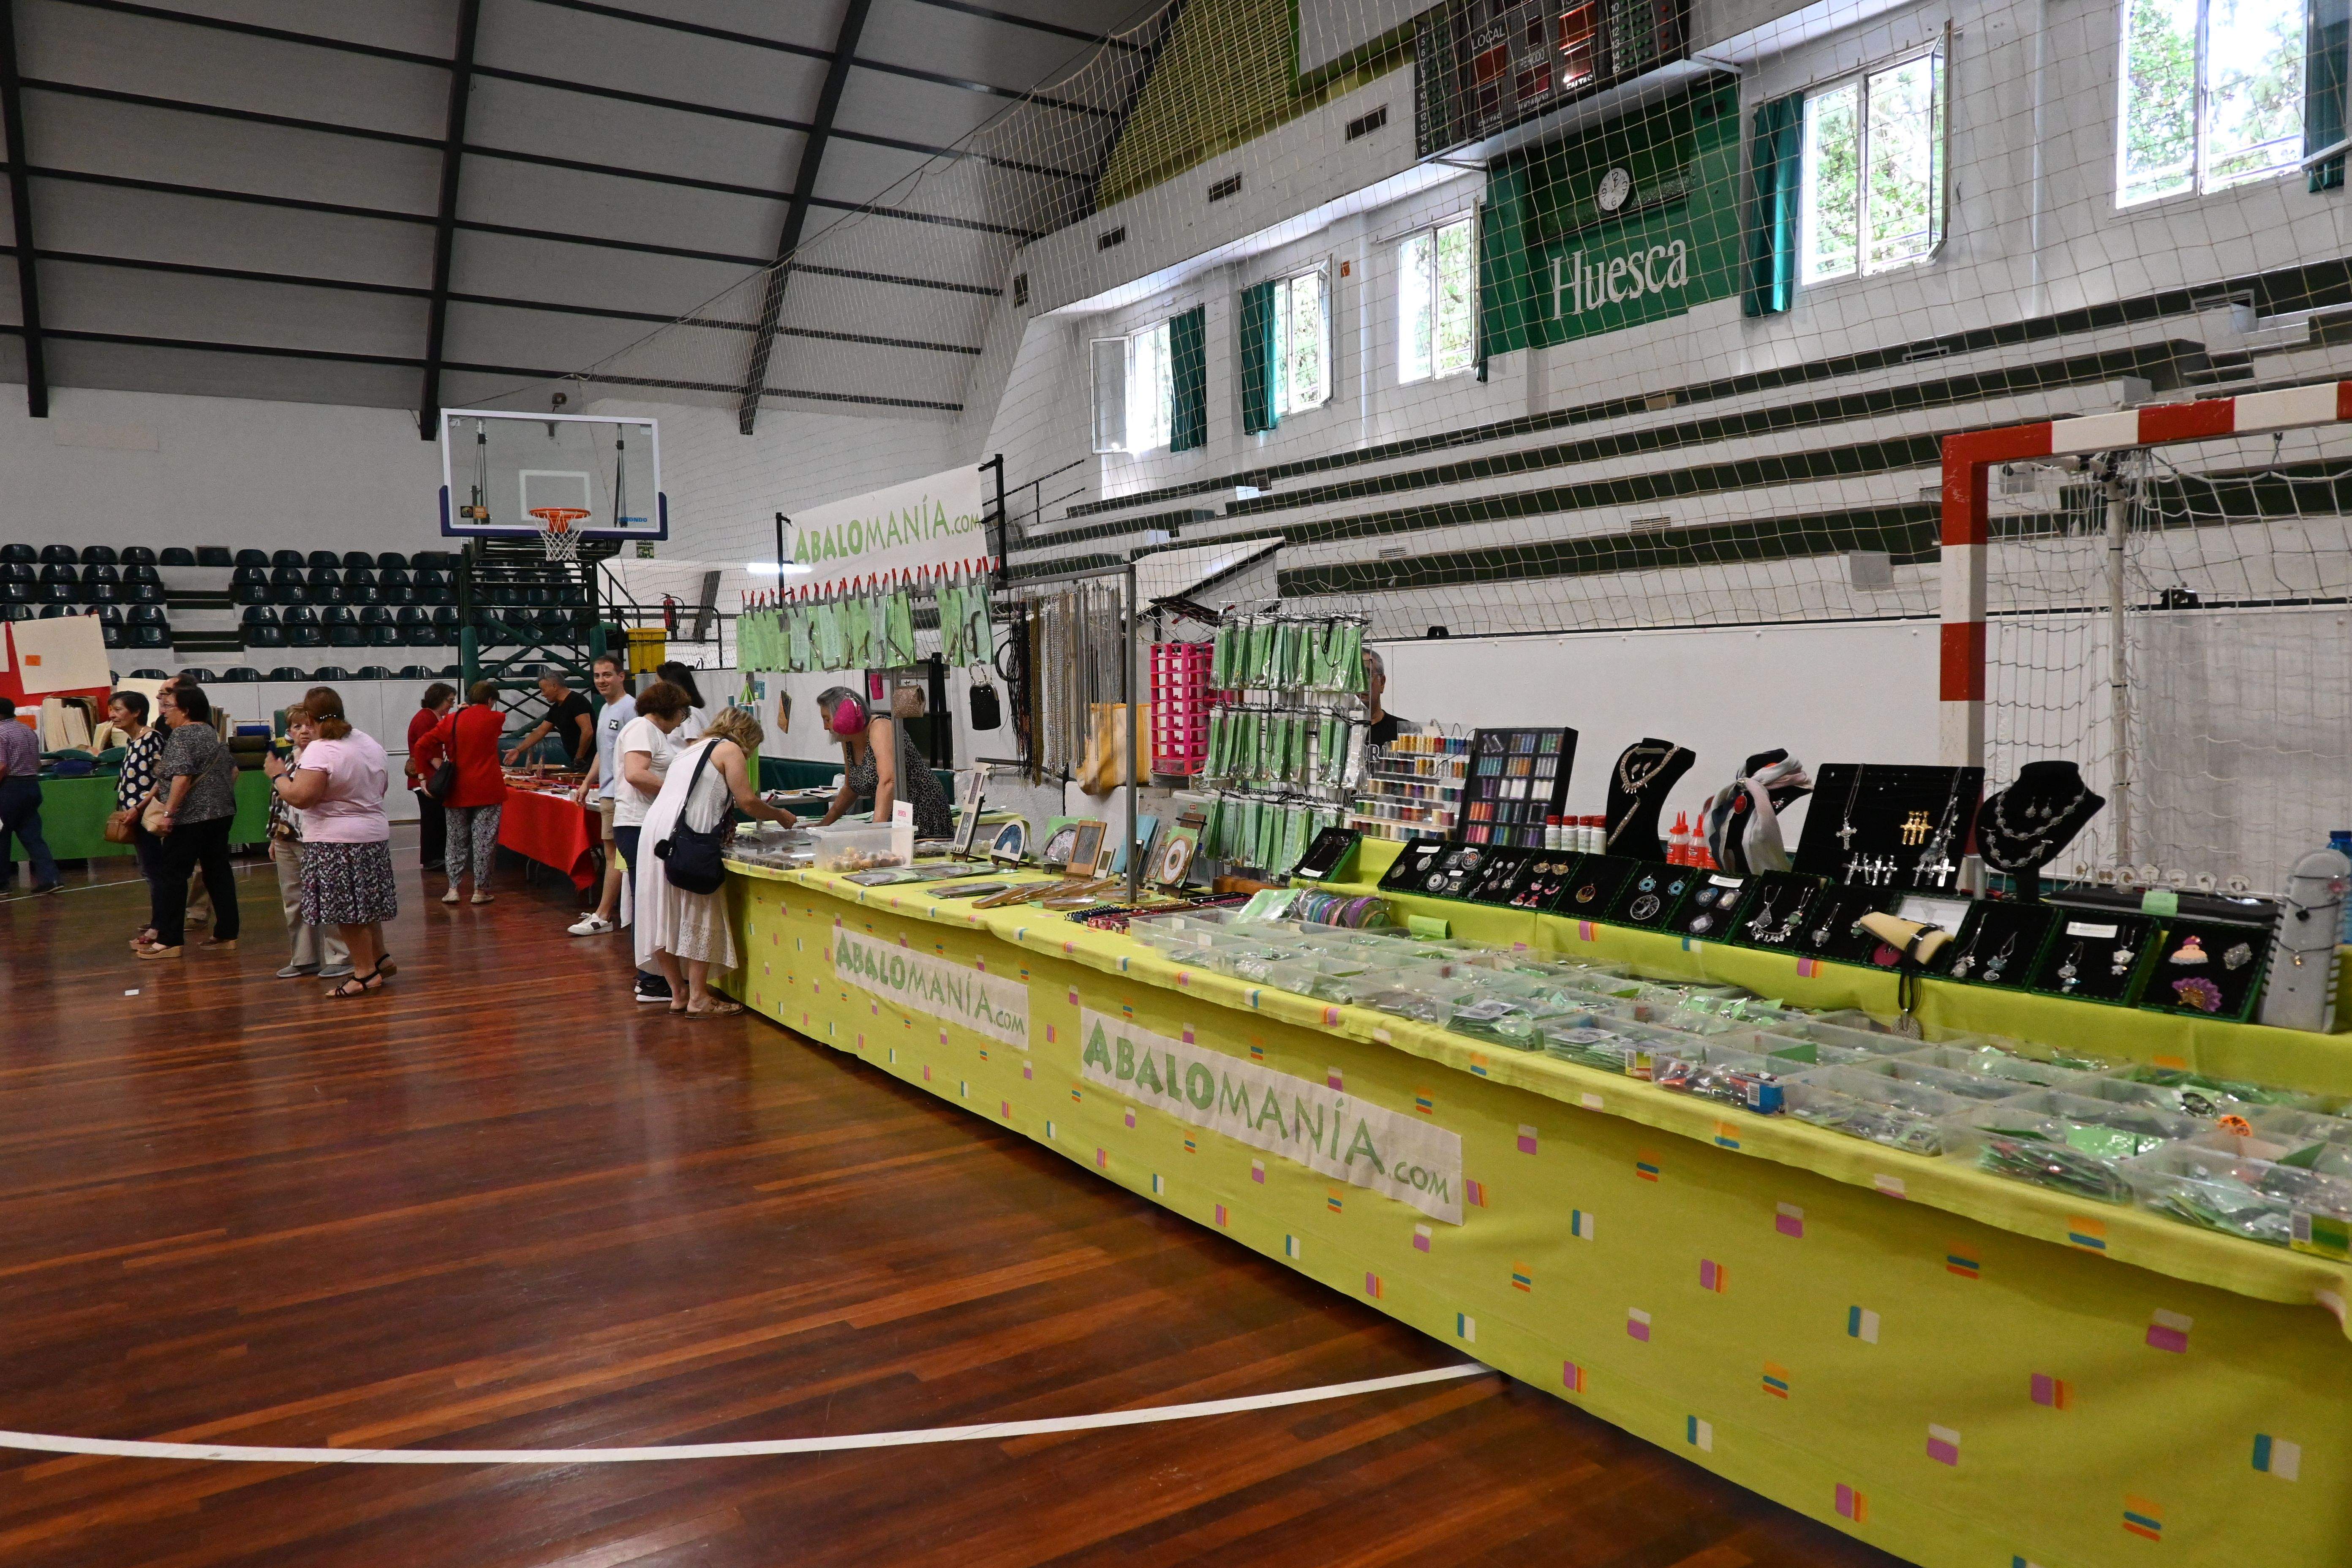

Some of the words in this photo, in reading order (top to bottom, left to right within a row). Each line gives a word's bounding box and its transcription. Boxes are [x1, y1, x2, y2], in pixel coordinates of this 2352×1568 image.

[1610, 3, 1619, 13] 10
[1611, 14, 1619, 24] 11
[1611, 26, 1620, 37] 12
[1421, 37, 1426, 46] 5
[1472, 25, 1505, 50] LOCAL
[1612, 39, 1620, 49] 13
[1421, 49, 1426, 57] 6
[1612, 51, 1620, 61] 14
[1421, 59, 1426, 68] 7
[1612, 63, 1620, 74] 15
[1420, 91, 1426, 100] 10
[1421, 101, 1426, 111] 11
[1420, 112, 1426, 121] 12
[1420, 122, 1427, 132] 13
[1421, 133, 1427, 142] 14
[1421, 144, 1427, 153] 15
[1612, 197, 1617, 206] 6
[1551, 239, 1689, 321] Huesca
